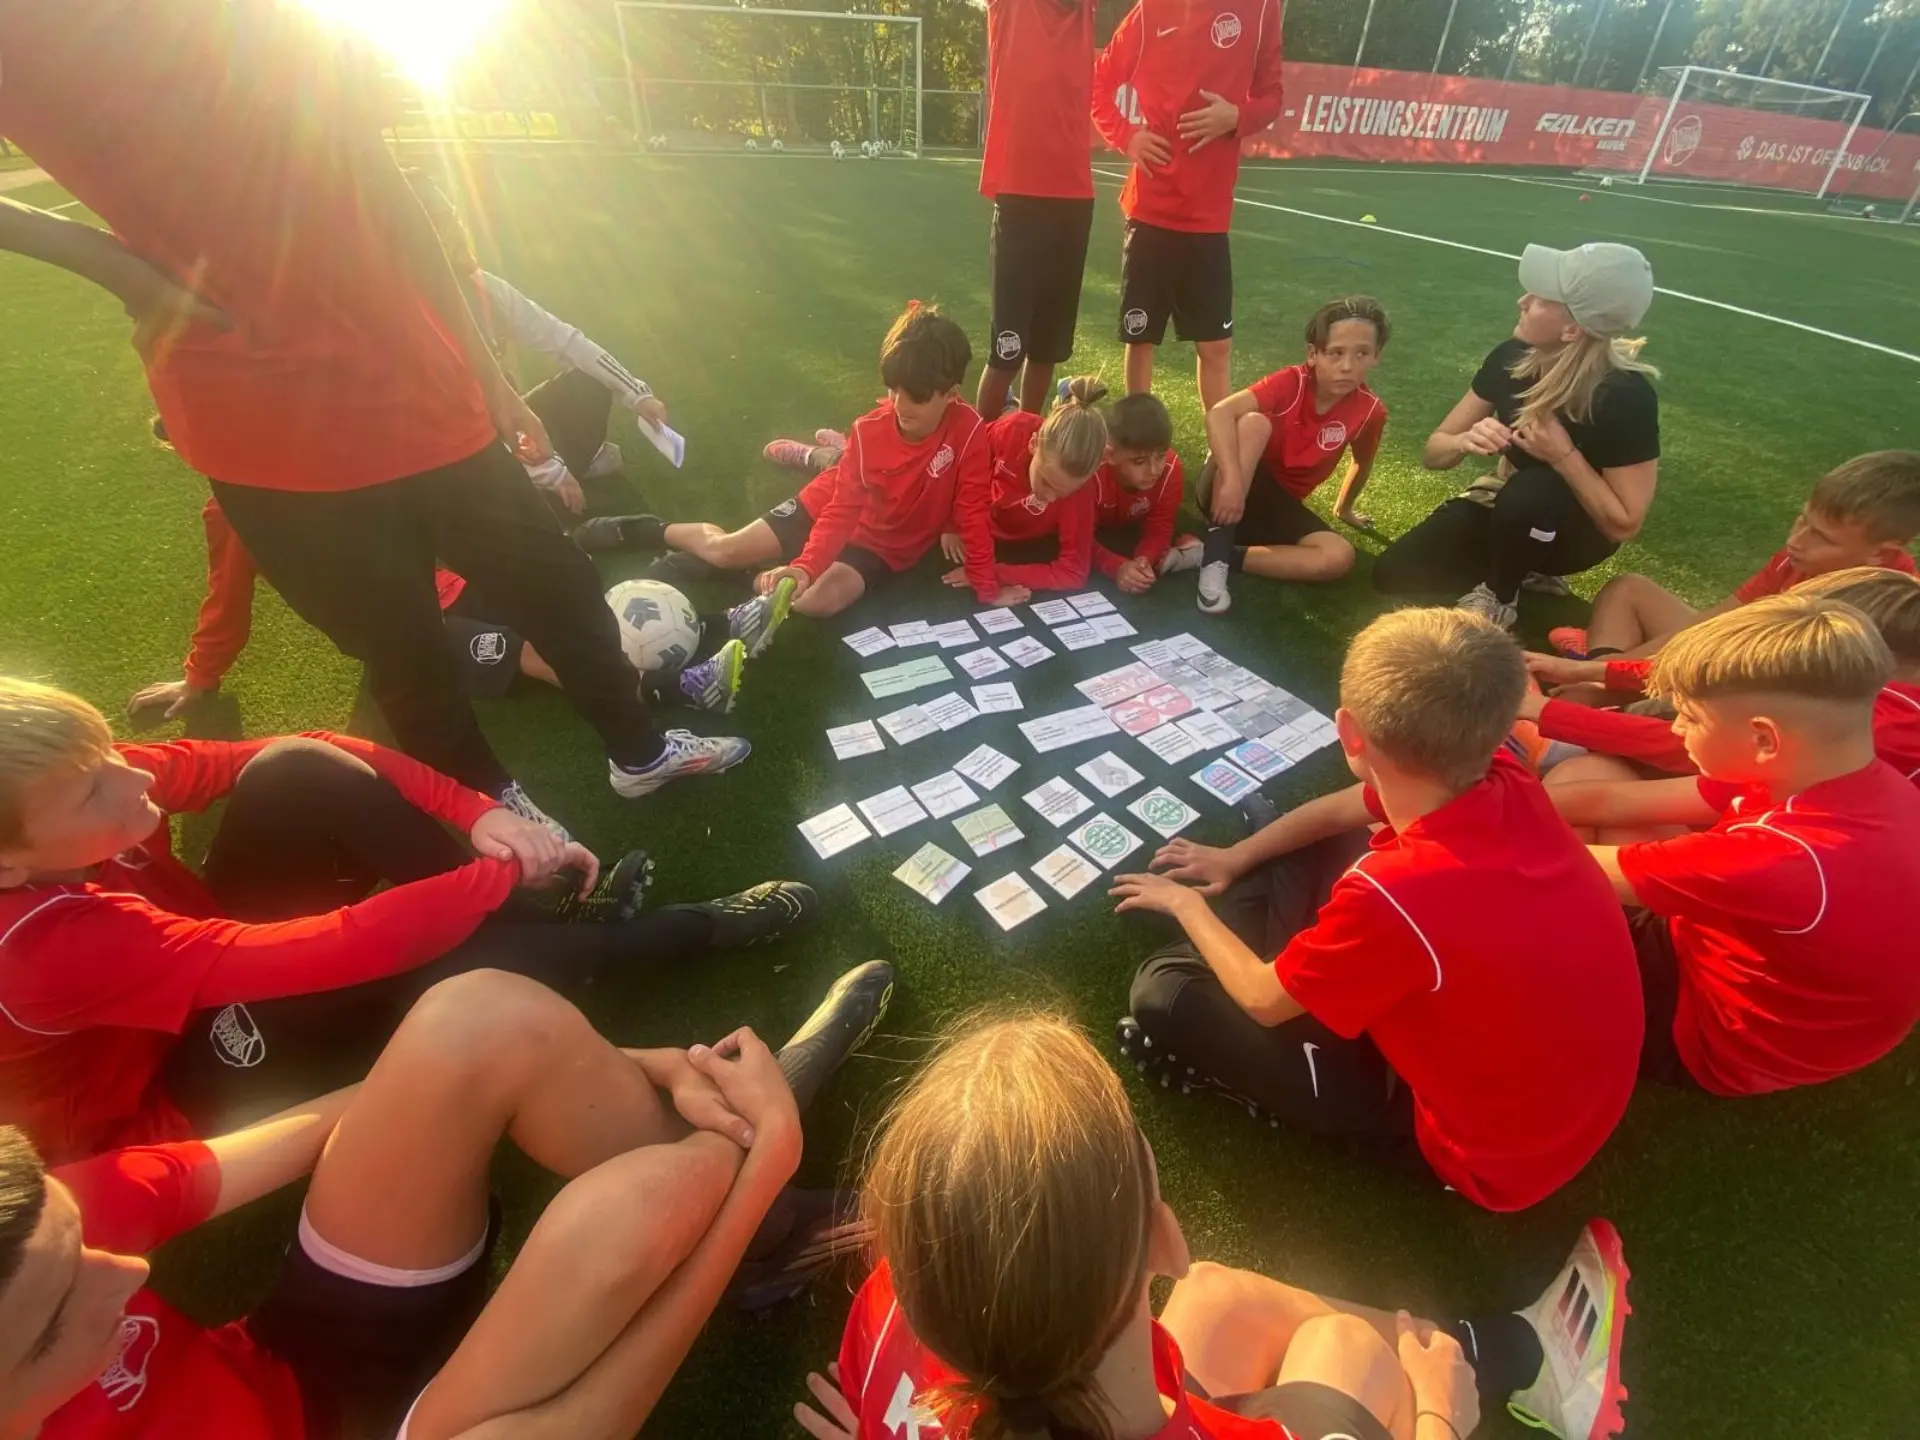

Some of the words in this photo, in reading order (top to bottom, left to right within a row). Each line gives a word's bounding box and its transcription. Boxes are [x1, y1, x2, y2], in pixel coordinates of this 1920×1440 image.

[1299, 95, 1509, 142] LEISTUNGSZENTRUM
[1535, 112, 1636, 138] FALKEN
[1756, 141, 1785, 162] DAS
[1787, 145, 1812, 164] IST
[1811, 148, 1891, 173] OFENBACH
